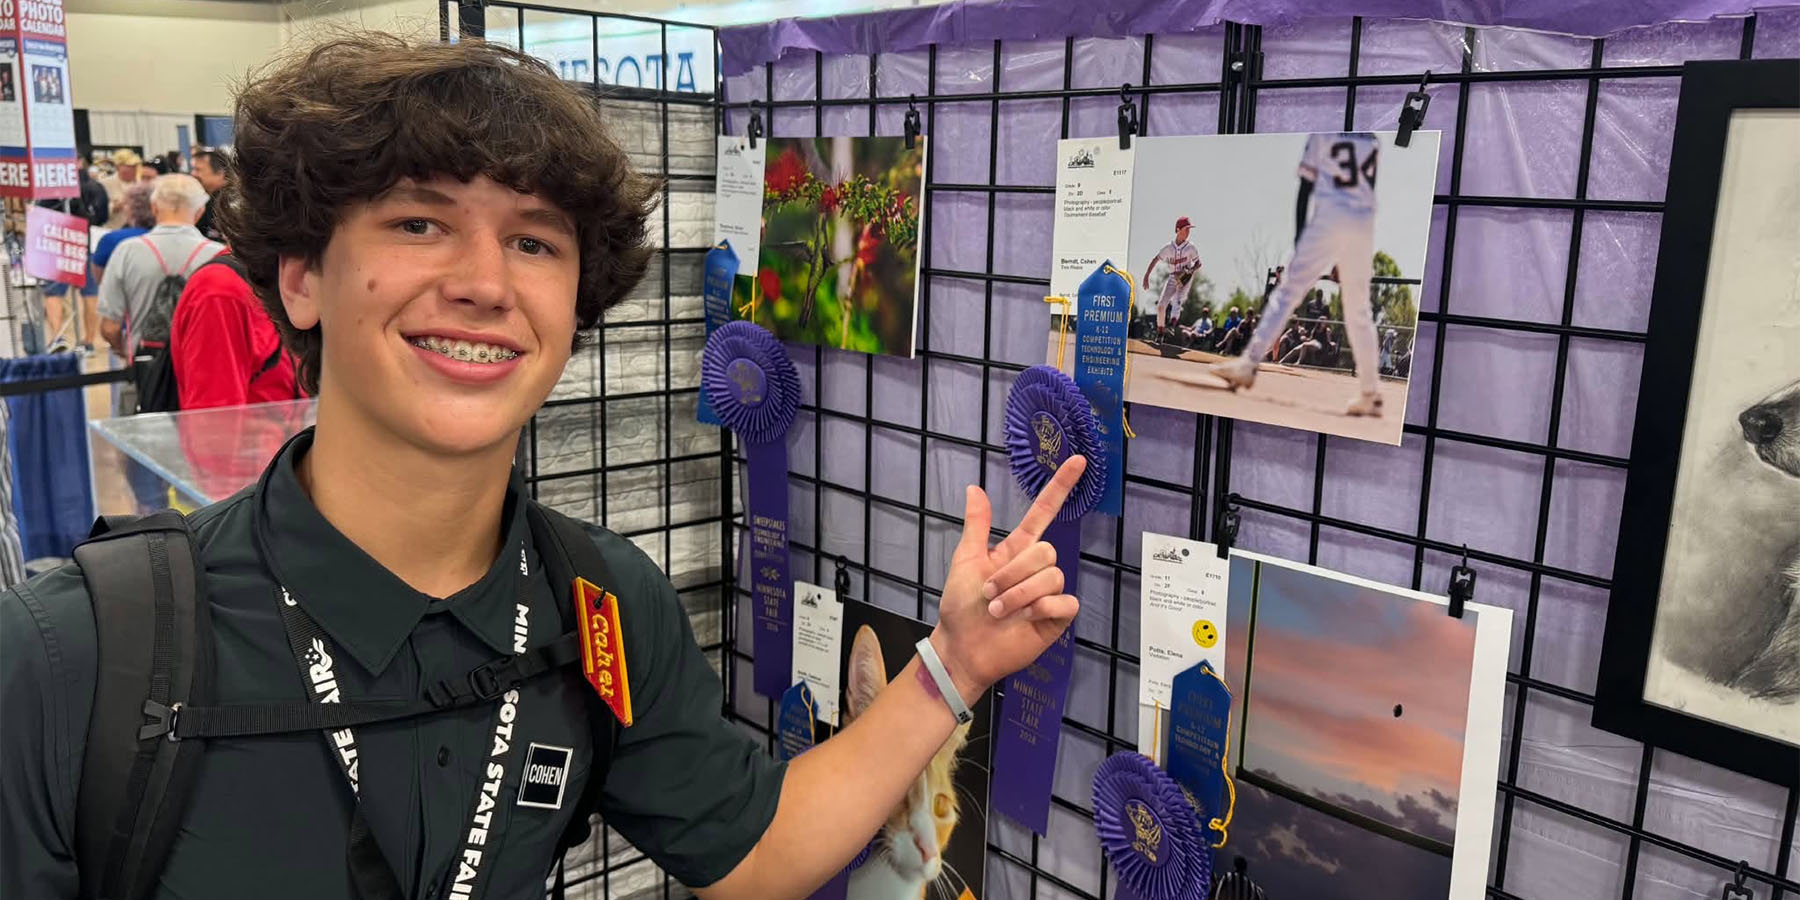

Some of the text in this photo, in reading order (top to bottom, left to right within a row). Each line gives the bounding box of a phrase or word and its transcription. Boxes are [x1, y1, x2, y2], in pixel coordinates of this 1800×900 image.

[20, 0, 63, 24] PHOTO
[21, 18, 65, 37] CALENDAR
[0, 161, 30, 188] ERE
[35, 161, 78, 188] HERE
[1092, 295, 1116, 308] FIRST
[1083, 309, 1123, 323] PREMIUM
[1083, 335, 1121, 346] COMPETITION
[1081, 345, 1122, 356] TECHNOLOGY &
[1082, 355, 1120, 366] ENGINEERING
[1087, 366, 1114, 376] EXHIBITS
[1012, 679, 1056, 711] MINNESOTA
[1022, 698, 1043, 715] STATE
[1021, 712, 1040, 730] FAIR
[528, 763, 563, 787] COHEN
[468, 762, 505, 846] STATE
